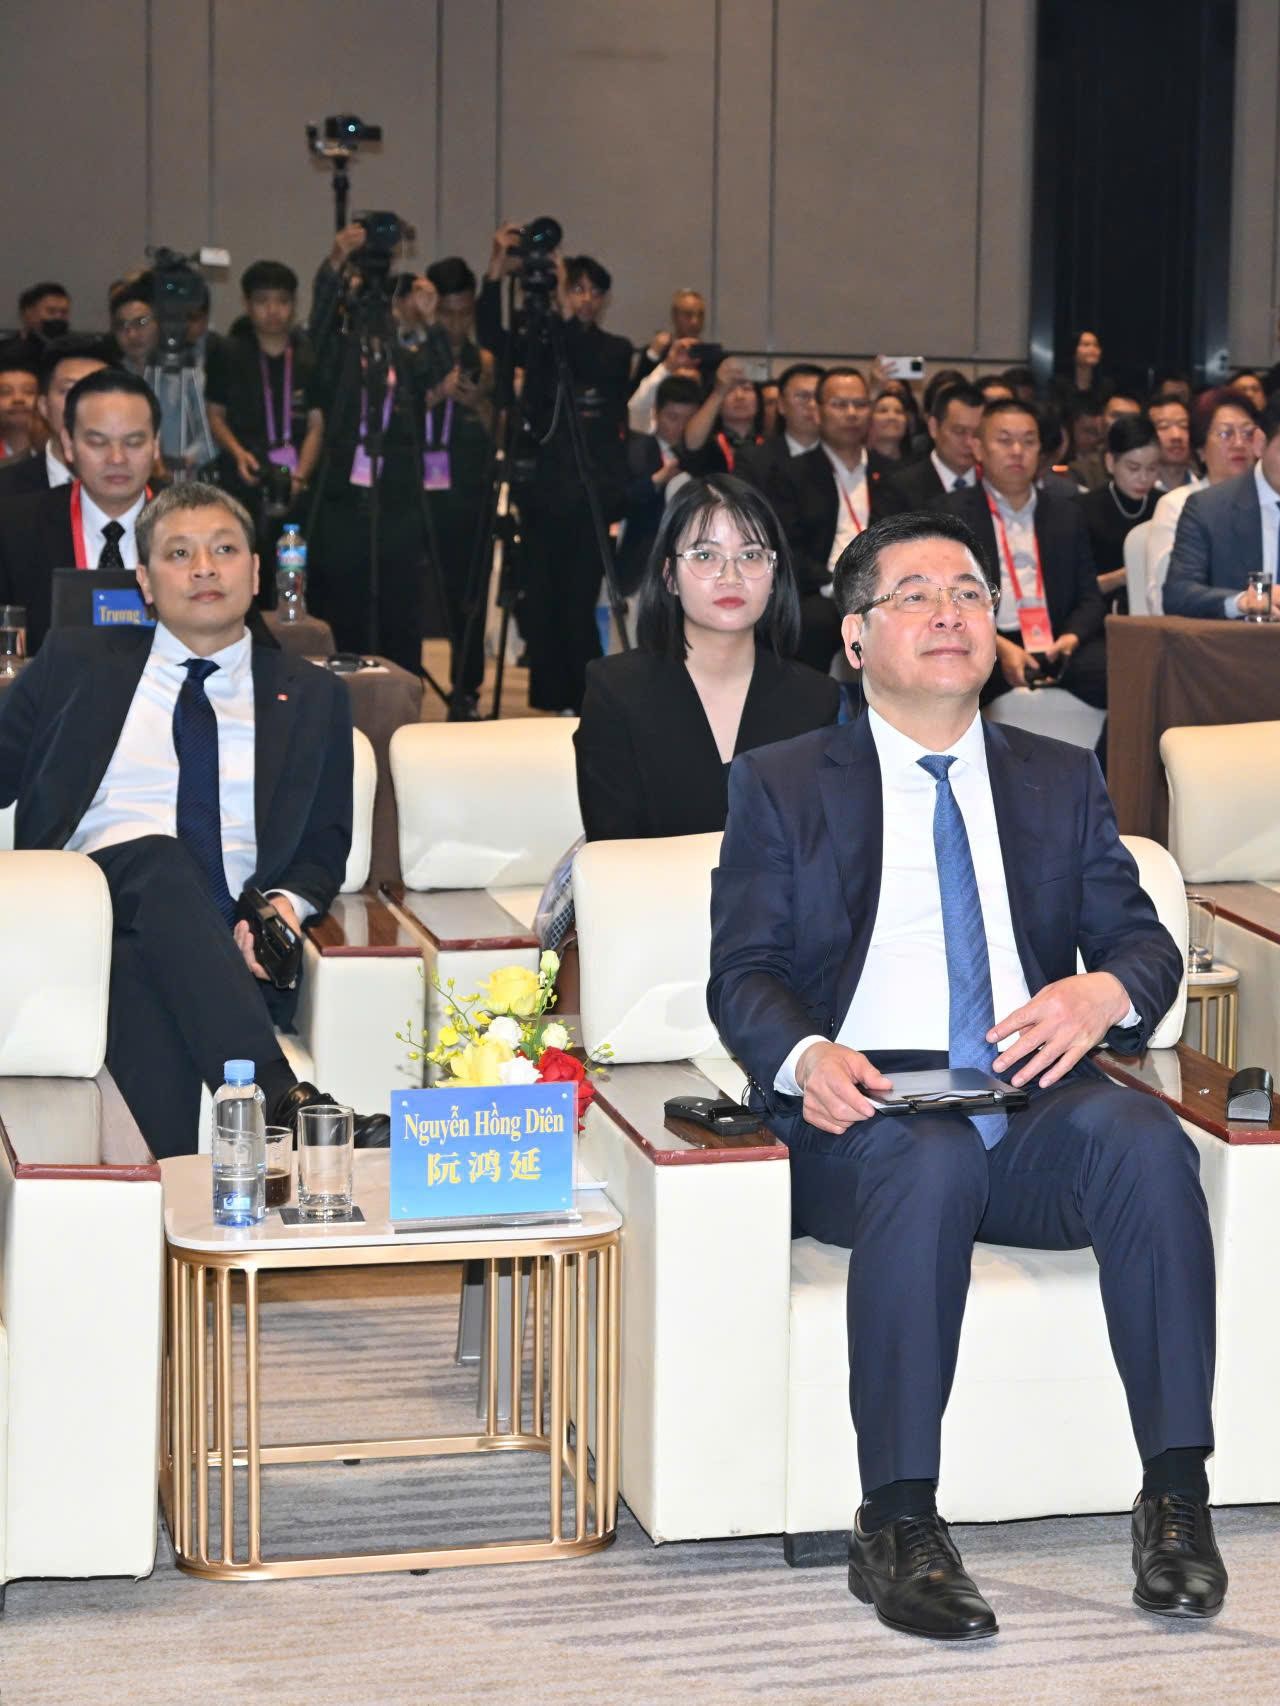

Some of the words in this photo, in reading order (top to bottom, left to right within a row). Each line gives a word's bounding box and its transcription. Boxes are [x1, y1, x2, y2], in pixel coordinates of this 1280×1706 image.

[403, 1105, 470, 1146] Nguyễn
[473, 1101, 522, 1142] Hồng
[524, 1106, 564, 1134] Diên
[426, 1147, 543, 1187] 阮鸿延
